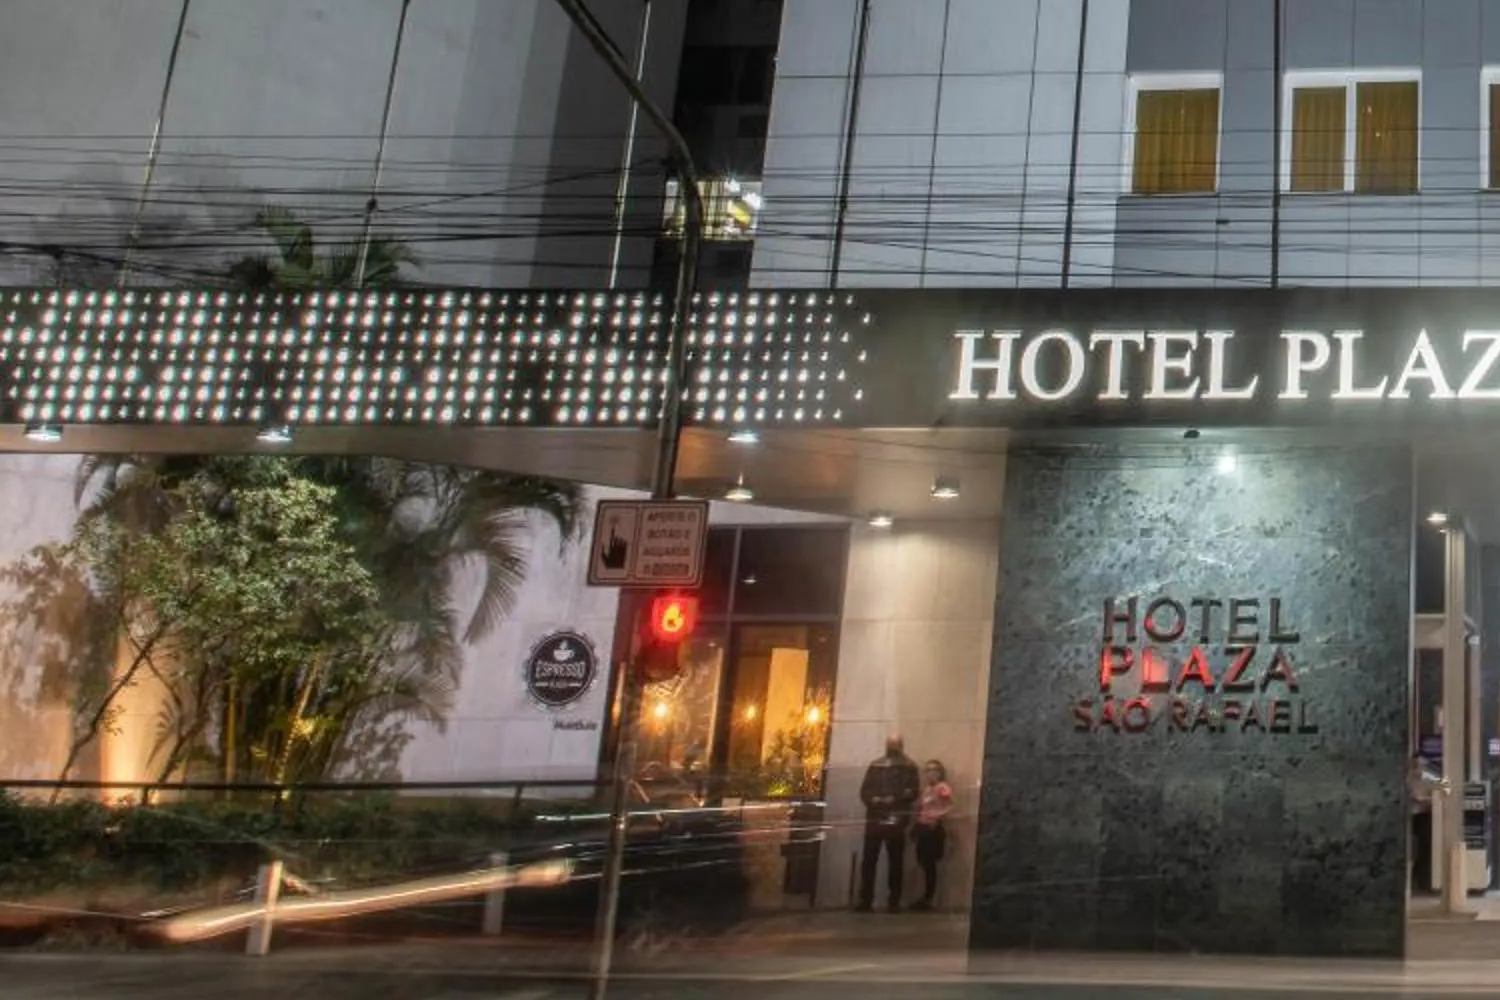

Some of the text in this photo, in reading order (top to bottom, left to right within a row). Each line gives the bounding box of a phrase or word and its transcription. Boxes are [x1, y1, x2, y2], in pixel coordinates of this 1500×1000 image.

[949, 328, 1260, 400] HOTEL
[1102, 597, 1300, 644] HOTEL
[535, 660, 587, 679] ESPRESSO
[1100, 645, 1300, 693] PLAZA
[1167, 699, 1319, 734] RAFAEL
